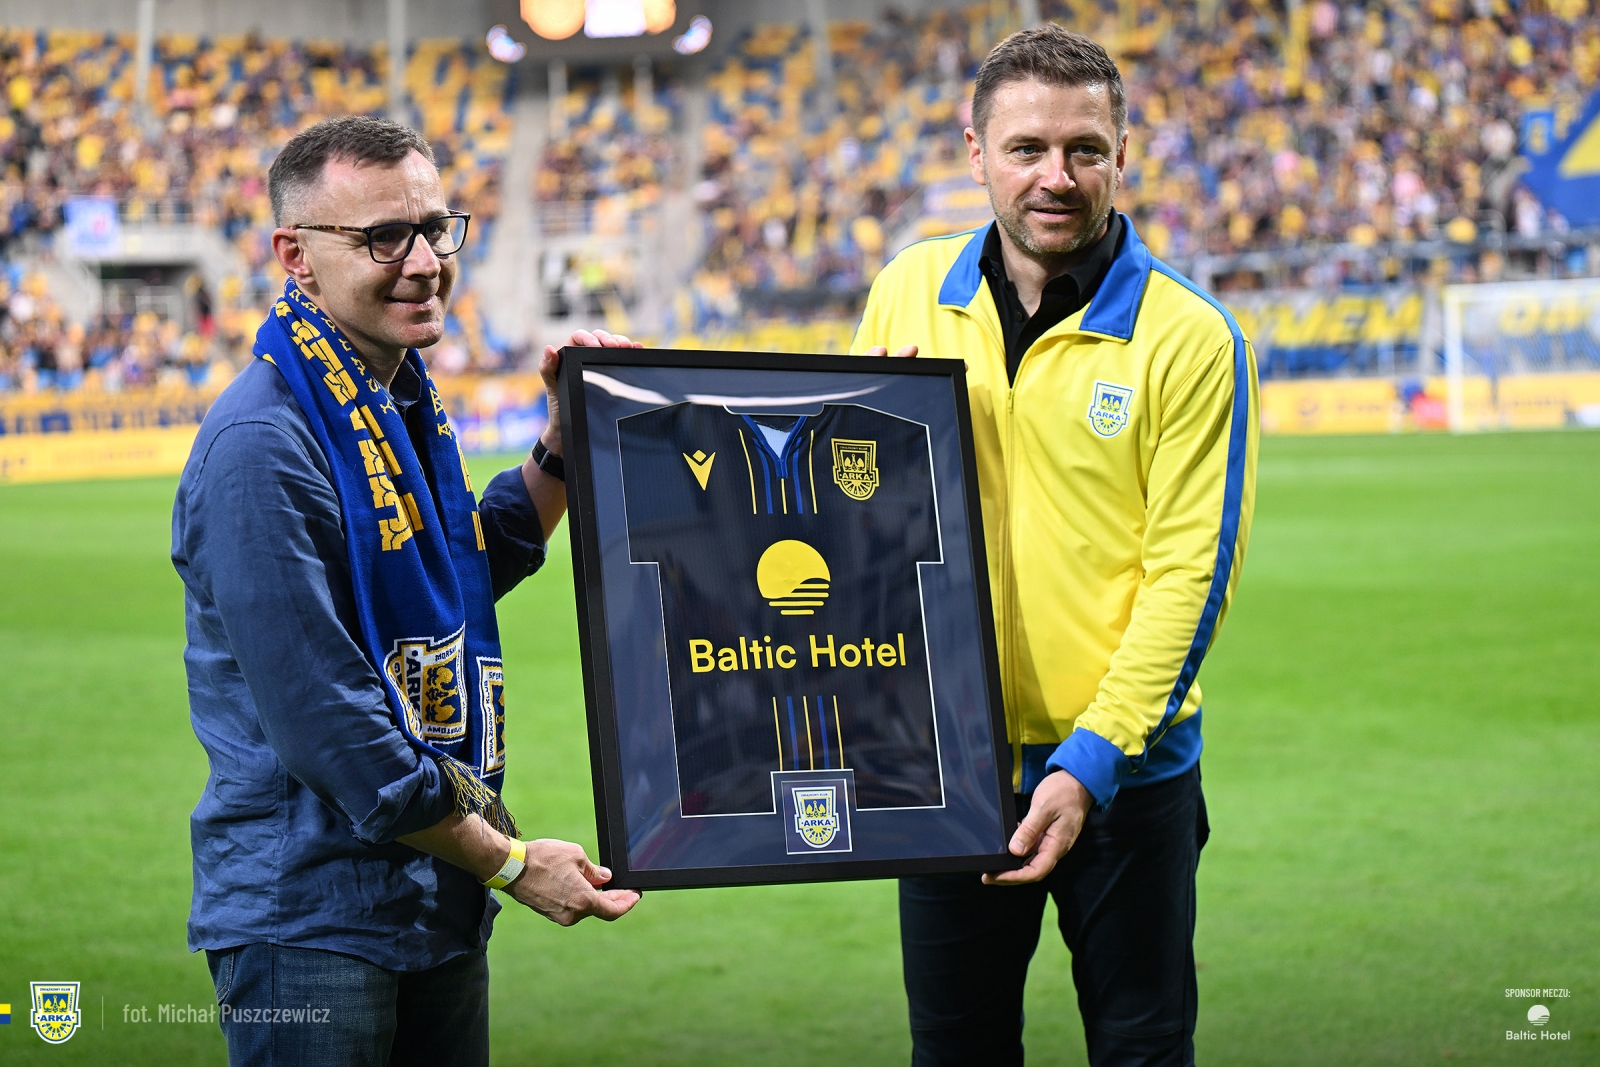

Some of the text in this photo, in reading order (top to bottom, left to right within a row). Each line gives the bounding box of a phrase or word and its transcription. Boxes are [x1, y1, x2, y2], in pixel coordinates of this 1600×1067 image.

[1095, 411, 1121, 421] ARKA
[841, 472, 871, 481] ARKA
[689, 633, 907, 673] Baltic Hotel
[405, 656, 422, 729] ARK
